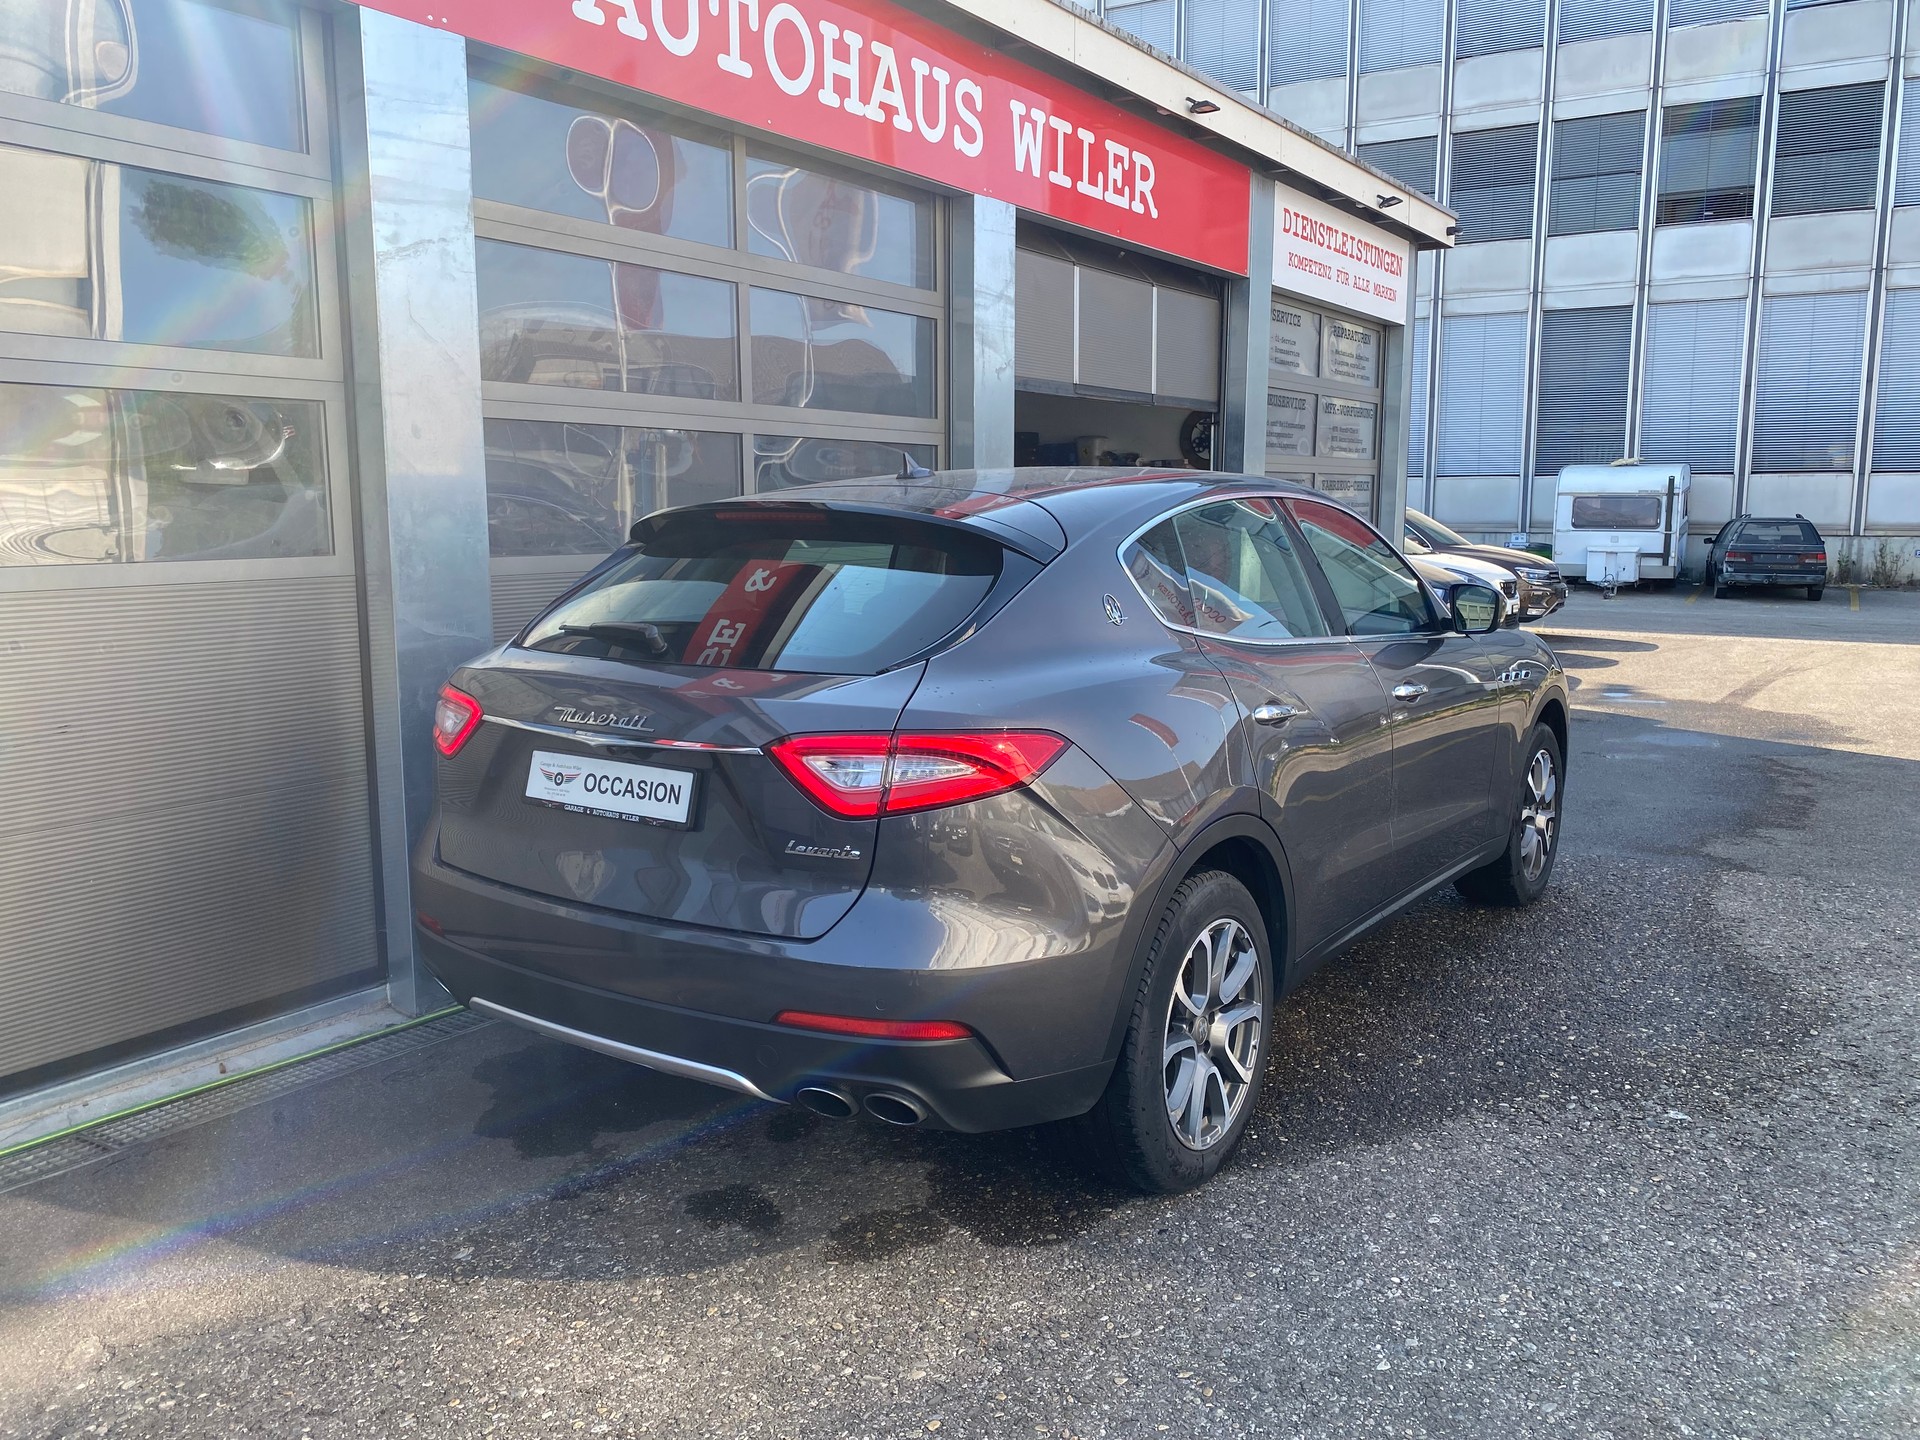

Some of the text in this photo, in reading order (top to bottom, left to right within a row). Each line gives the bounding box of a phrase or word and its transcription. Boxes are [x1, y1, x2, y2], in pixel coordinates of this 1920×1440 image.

[1009, 99, 1159, 219] WILER
[1282, 207, 1403, 278] DIENSTLEISTUNGEN
[1288, 251, 1332, 280] KOMPETENZ
[1352, 275, 1371, 293] ALLE
[1373, 282, 1397, 302] MARKEN
[554, 706, 656, 733] Maserati
[583, 773, 682, 805] OCCASION
[621, 813, 640, 822] WILER
[784, 839, 861, 860] Levante
